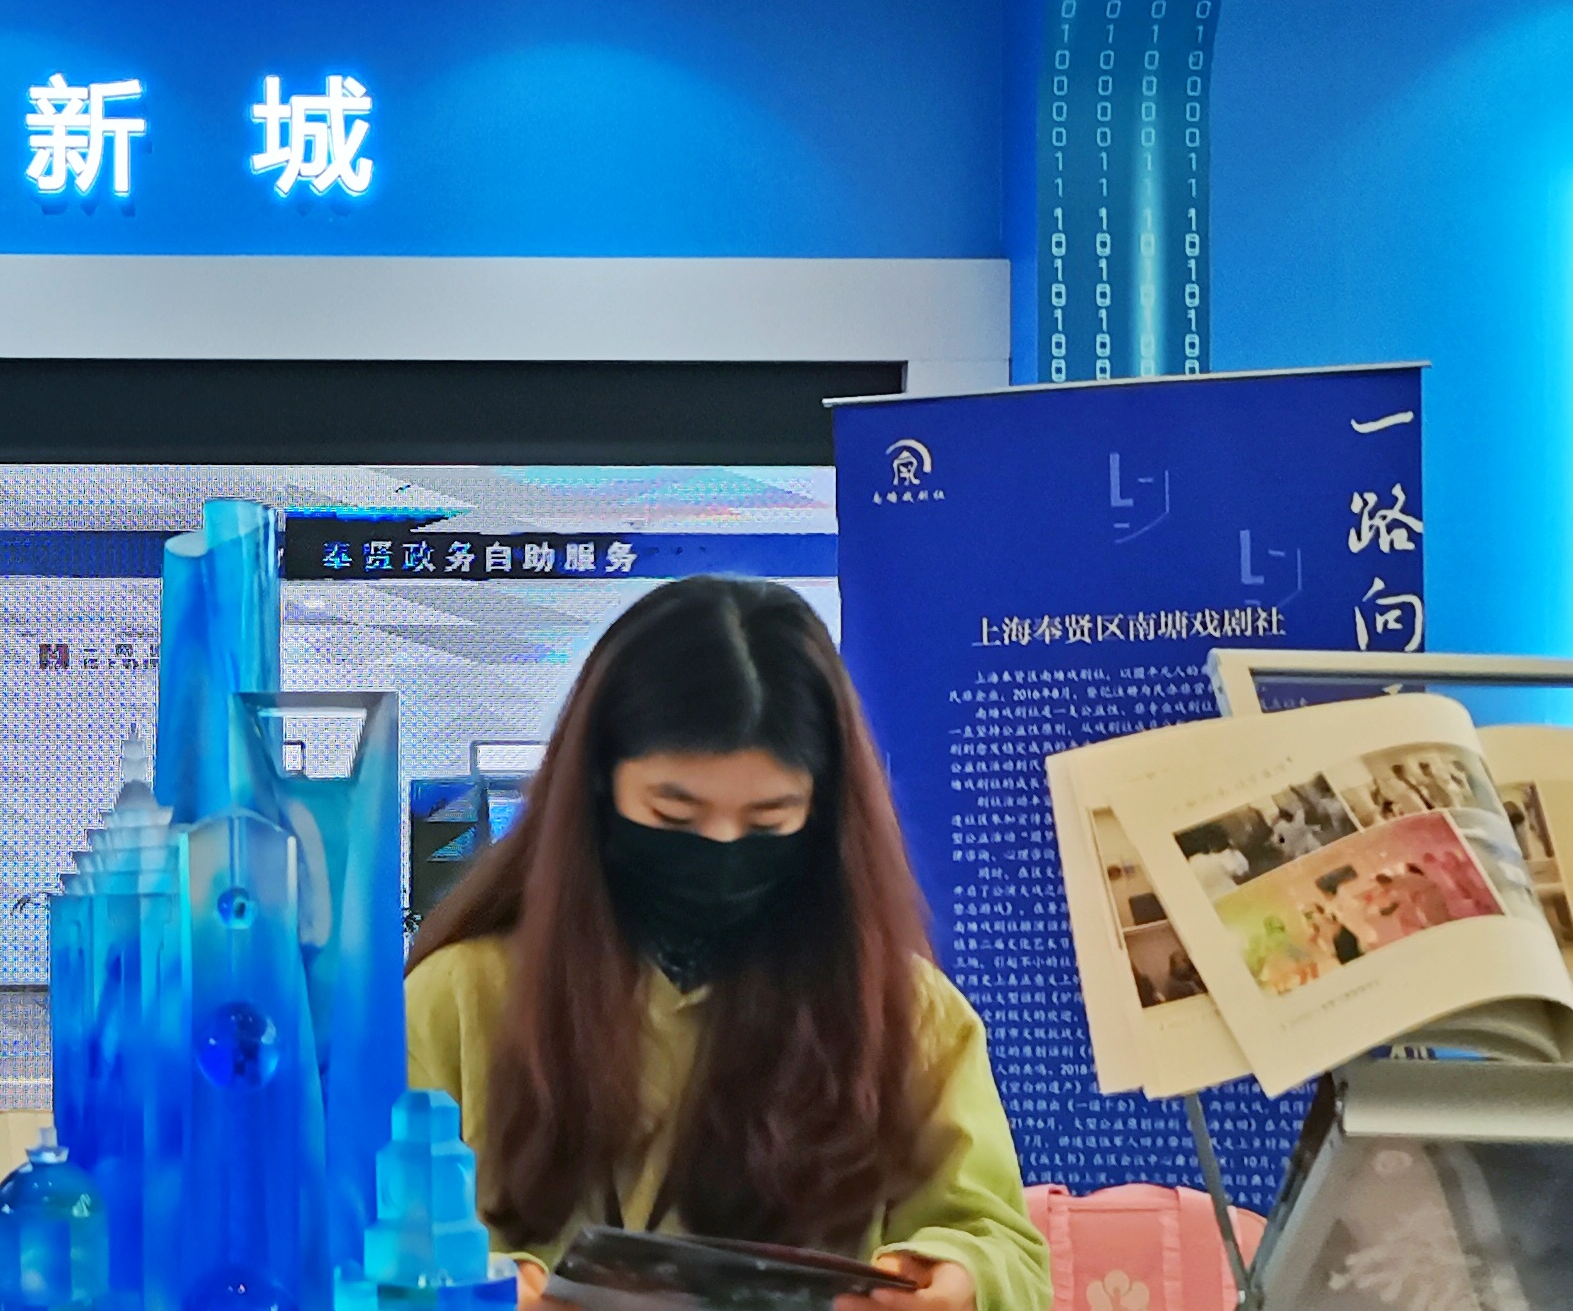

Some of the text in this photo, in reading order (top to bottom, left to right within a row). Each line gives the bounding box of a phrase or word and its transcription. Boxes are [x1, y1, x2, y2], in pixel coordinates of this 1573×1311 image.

[322, 540, 637, 573] 奉贤政务自助服务
[971, 606, 1286, 648] 上海奉贤区南塘戏剧社
